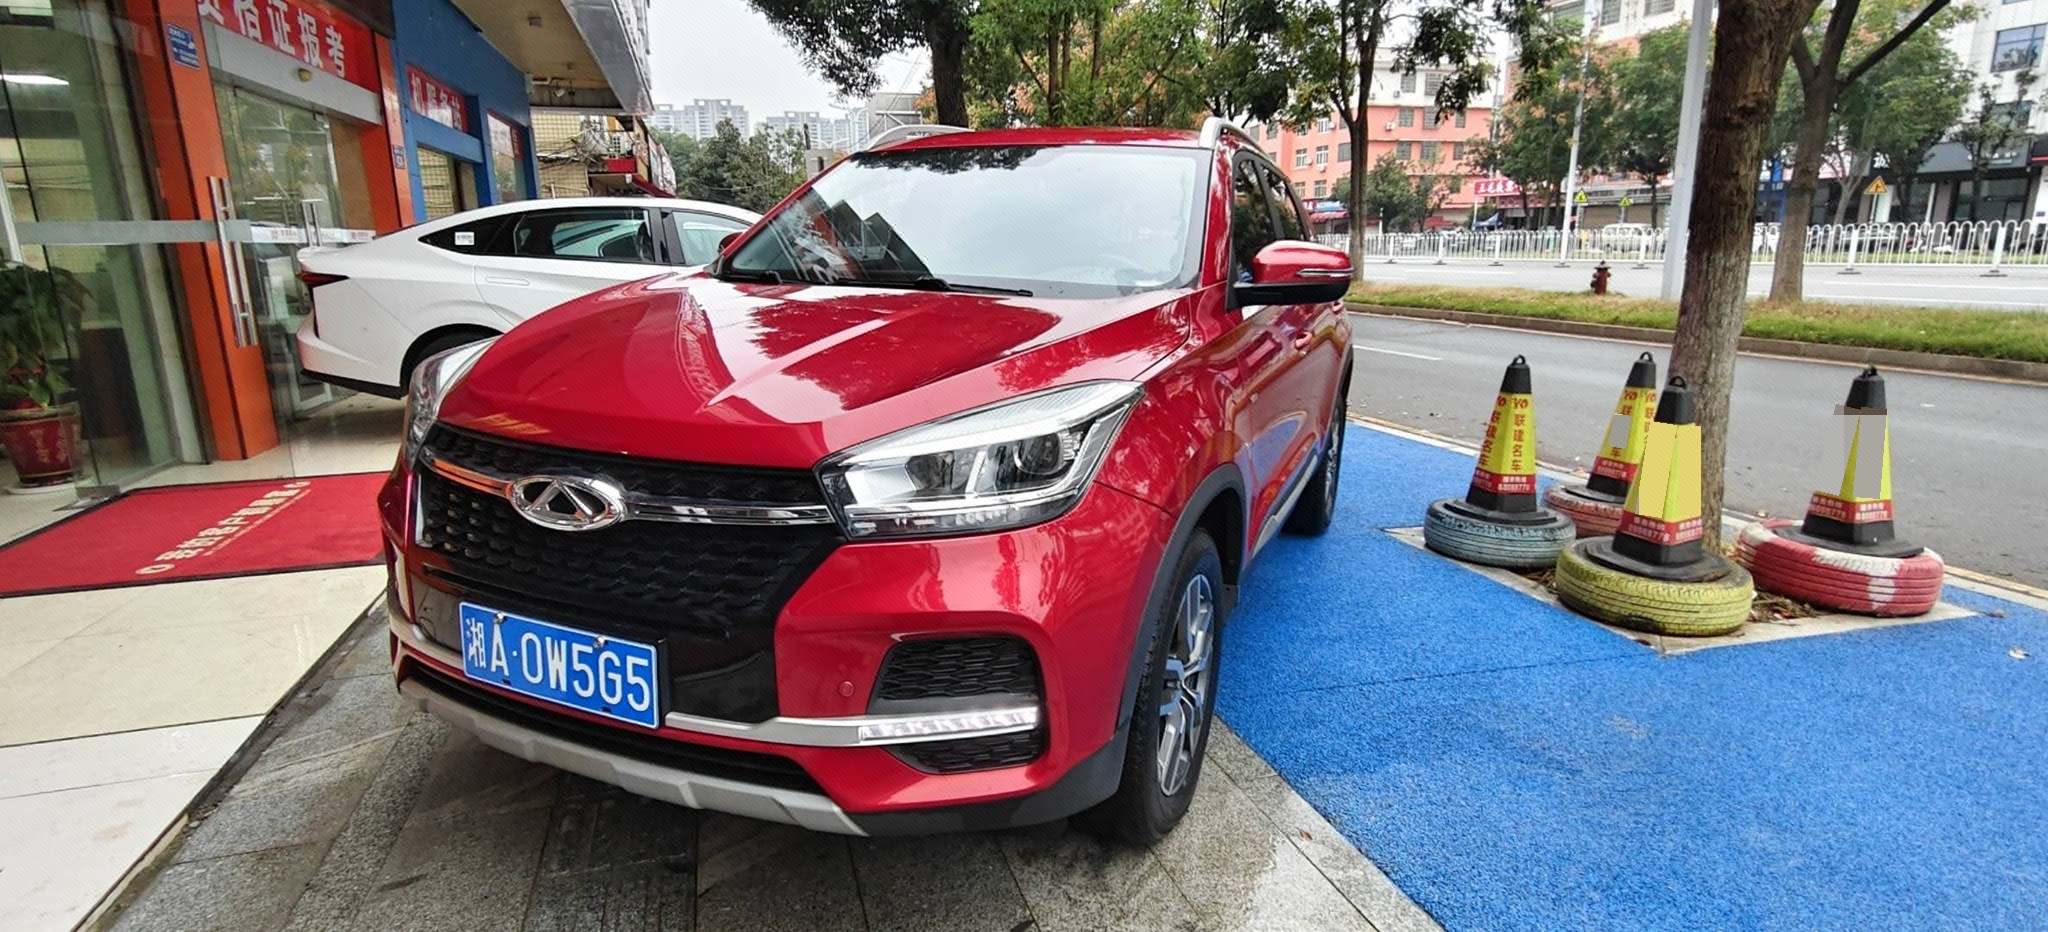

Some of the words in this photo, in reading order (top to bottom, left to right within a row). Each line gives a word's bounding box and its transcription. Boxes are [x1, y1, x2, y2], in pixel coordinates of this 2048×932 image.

[1511, 414, 1526, 471] 联建名车
[465, 617, 650, 712] 湘A·0W5G5
